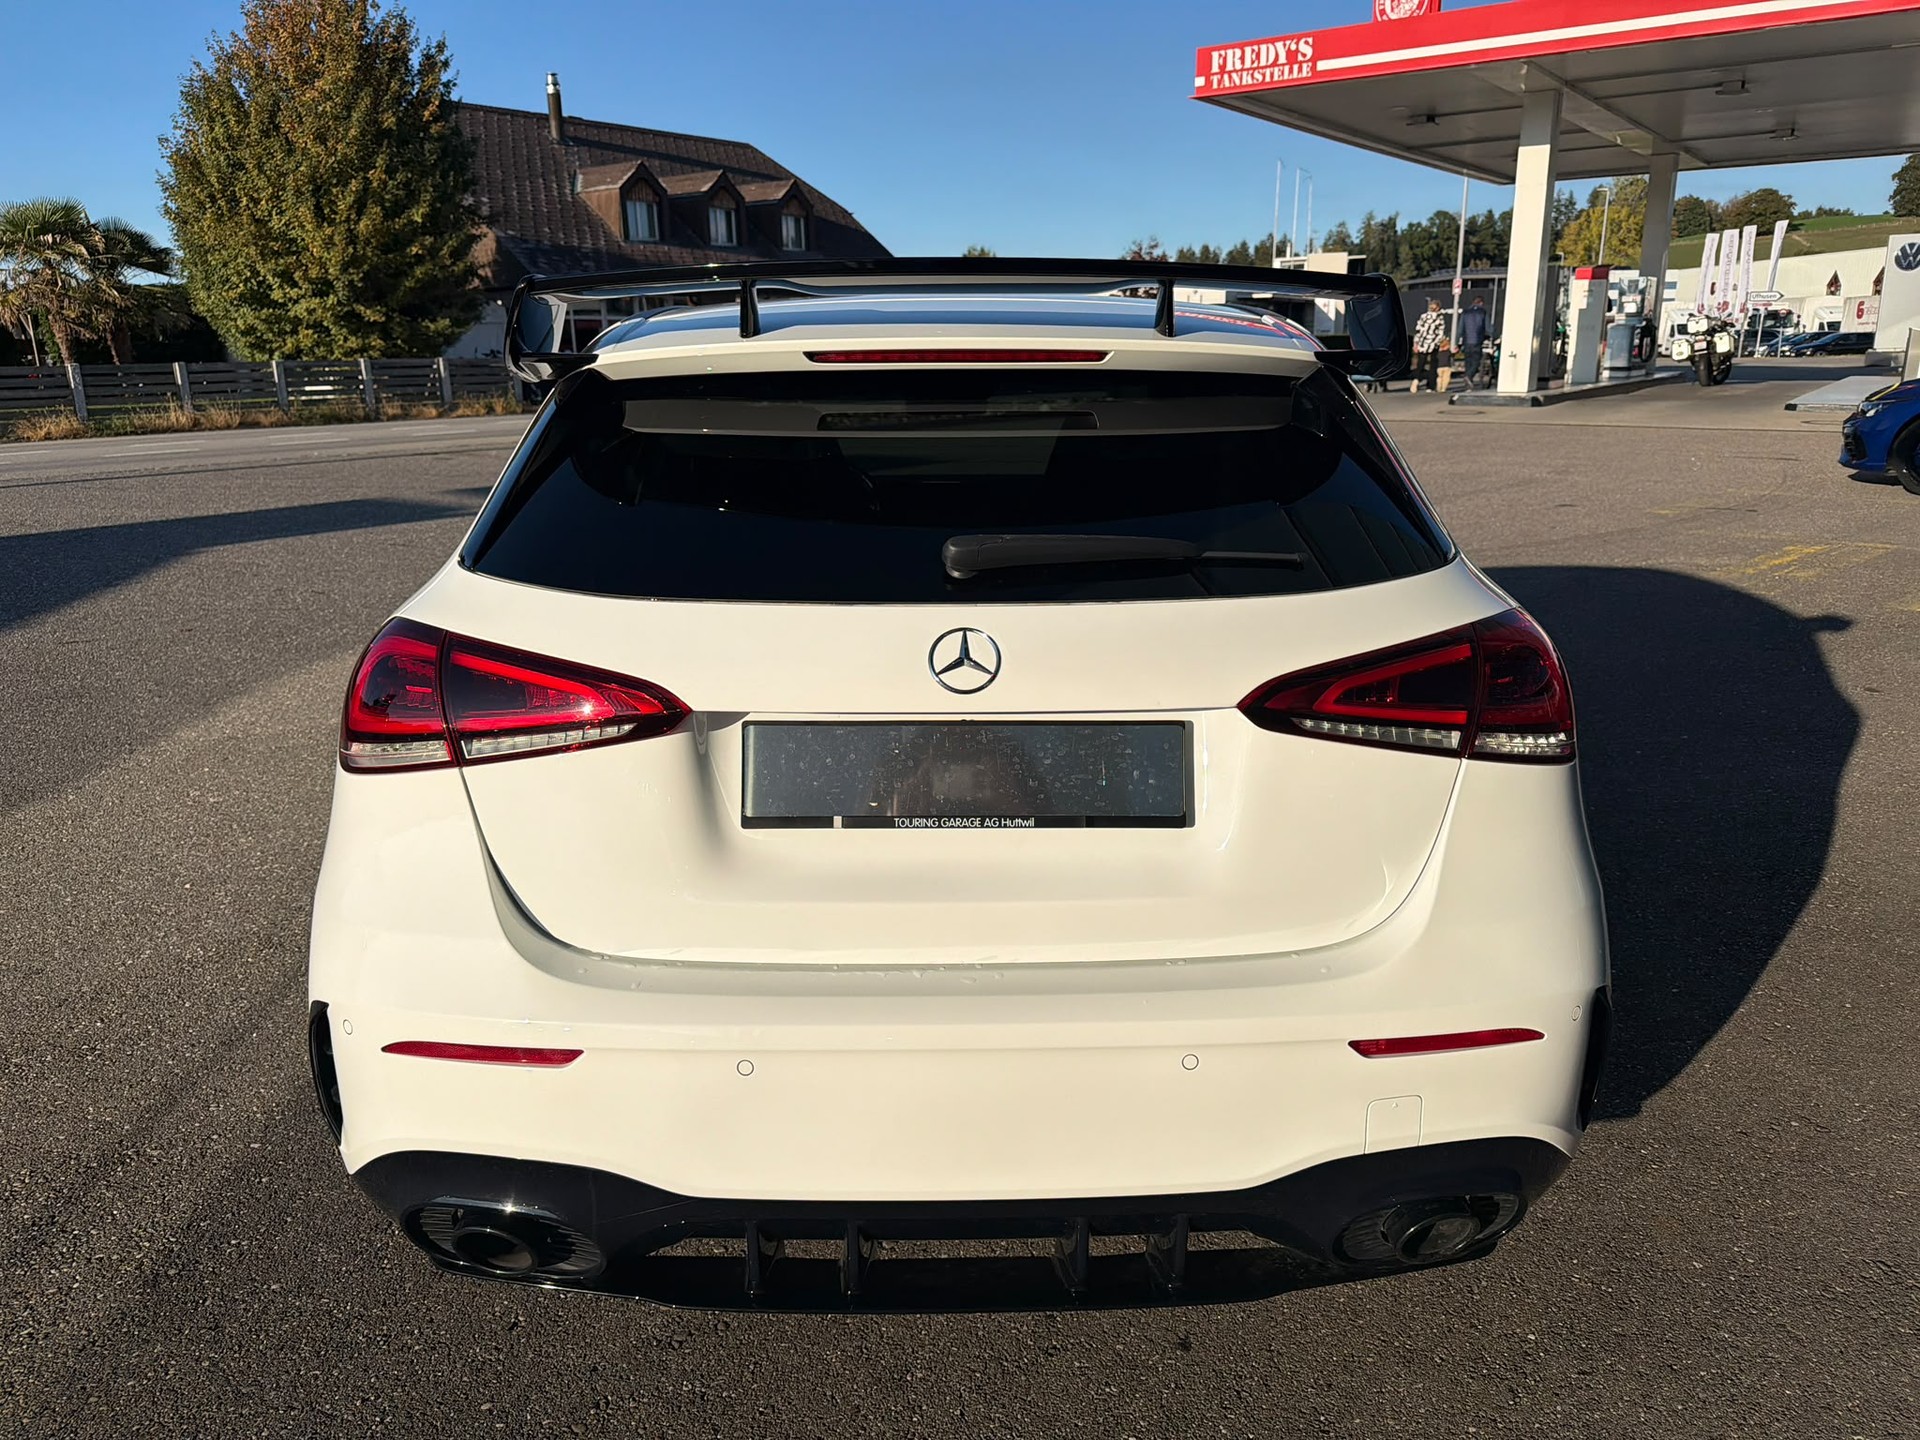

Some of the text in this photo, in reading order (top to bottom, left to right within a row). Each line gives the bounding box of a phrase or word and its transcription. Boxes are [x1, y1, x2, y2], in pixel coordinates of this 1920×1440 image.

[1210, 37, 1313, 73] FREDY'S
[1210, 61, 1312, 89] TANKSTELLE
[894, 817, 1034, 828] TOURING GARAGE AG Huttwil
